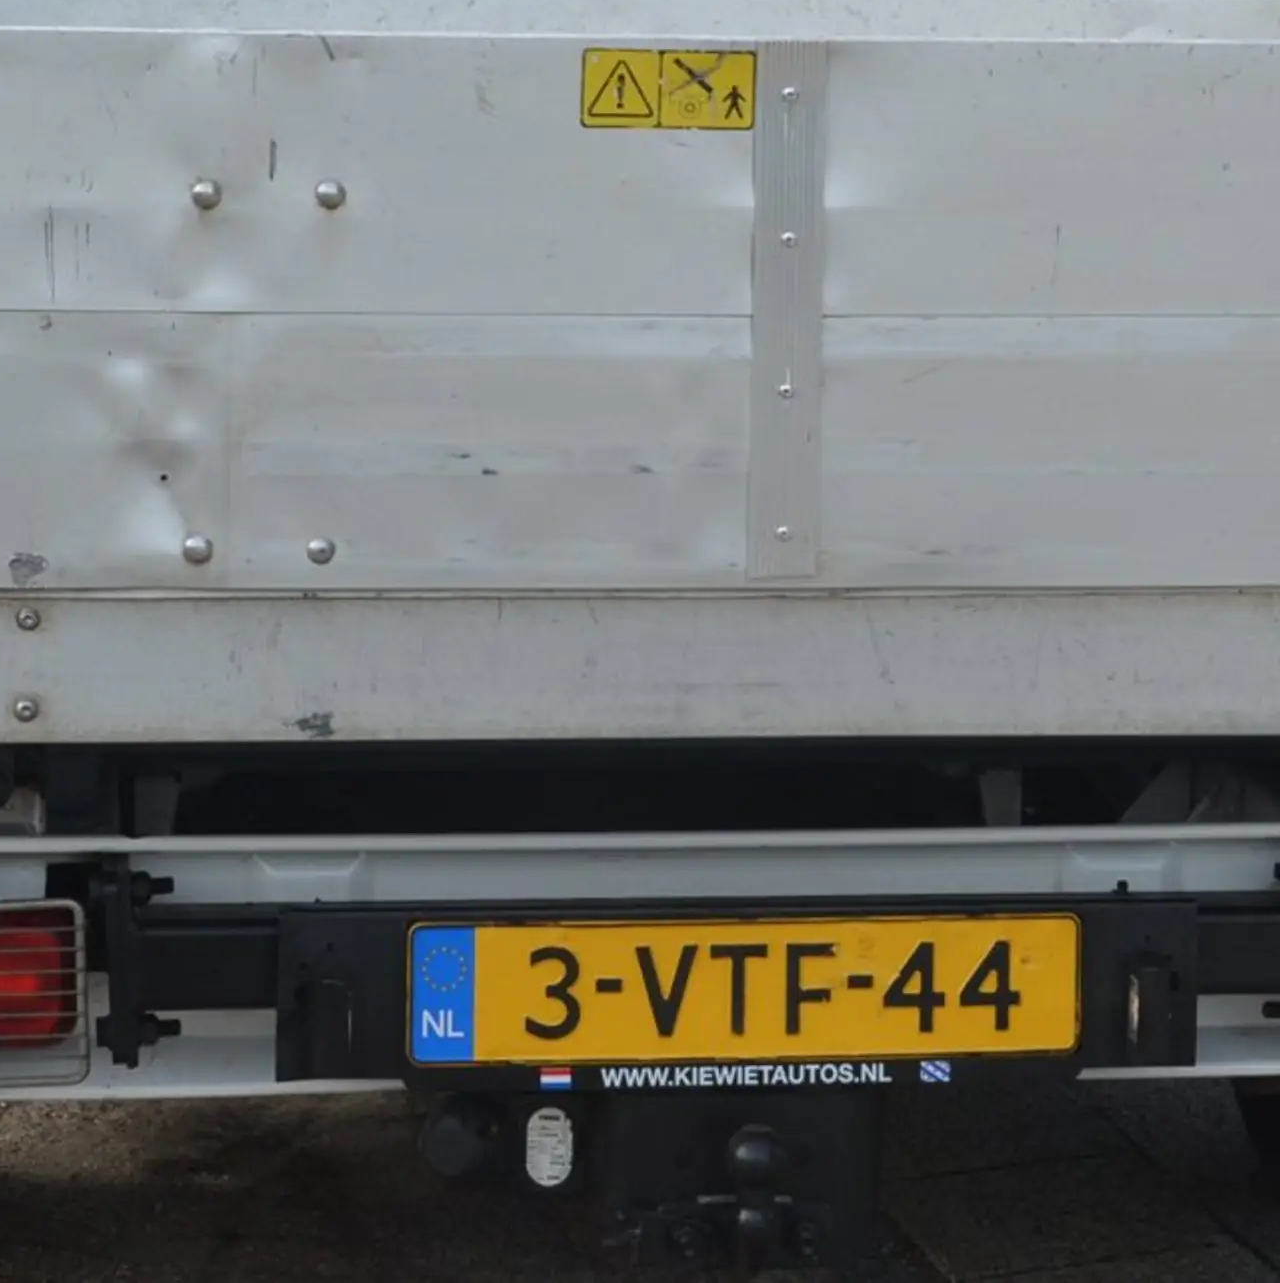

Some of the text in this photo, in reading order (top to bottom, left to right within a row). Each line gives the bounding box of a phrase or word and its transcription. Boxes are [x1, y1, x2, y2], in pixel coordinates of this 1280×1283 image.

[421, 939, 1021, 1041] NL 3-VTF-44
[600, 1063, 892, 1088] WWW.KIEWIETAUTOS.NL
